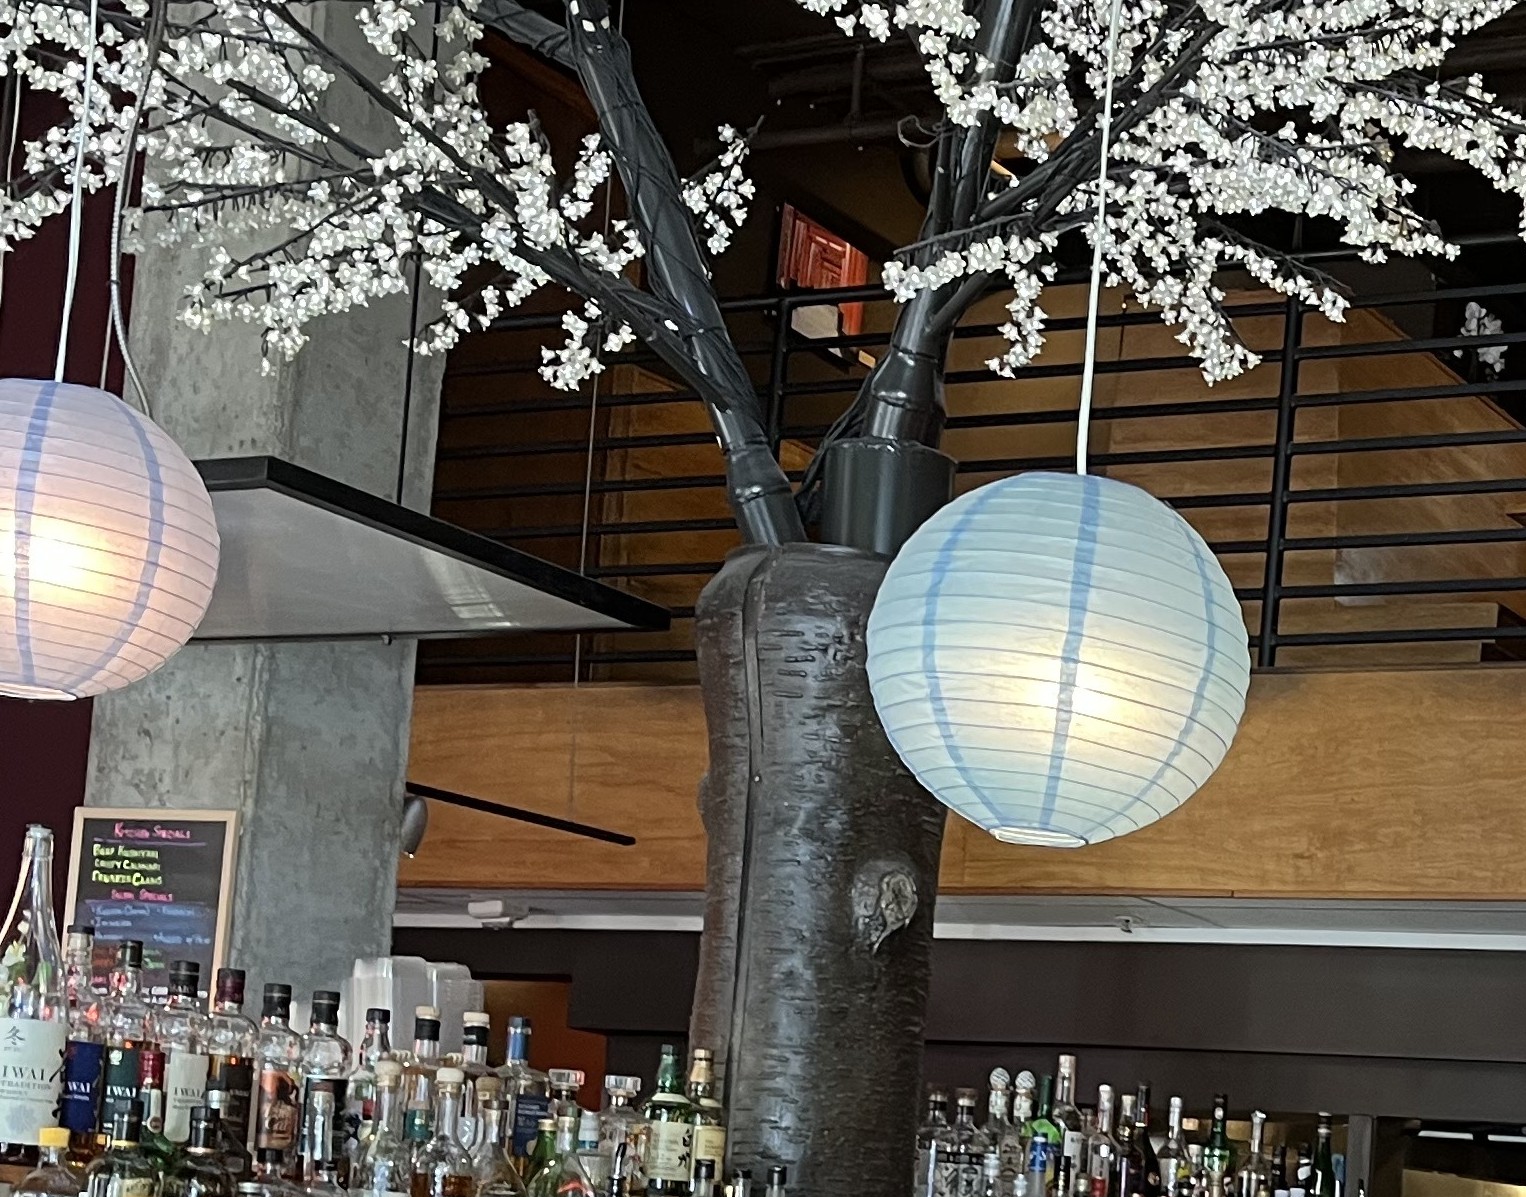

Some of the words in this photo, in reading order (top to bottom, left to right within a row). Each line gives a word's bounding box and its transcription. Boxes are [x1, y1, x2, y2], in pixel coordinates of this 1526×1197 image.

[2, 1065, 45, 1081] IWAI
[66, 1081, 91, 1094] WAI
[105, 1085, 137, 1098] IWAI
